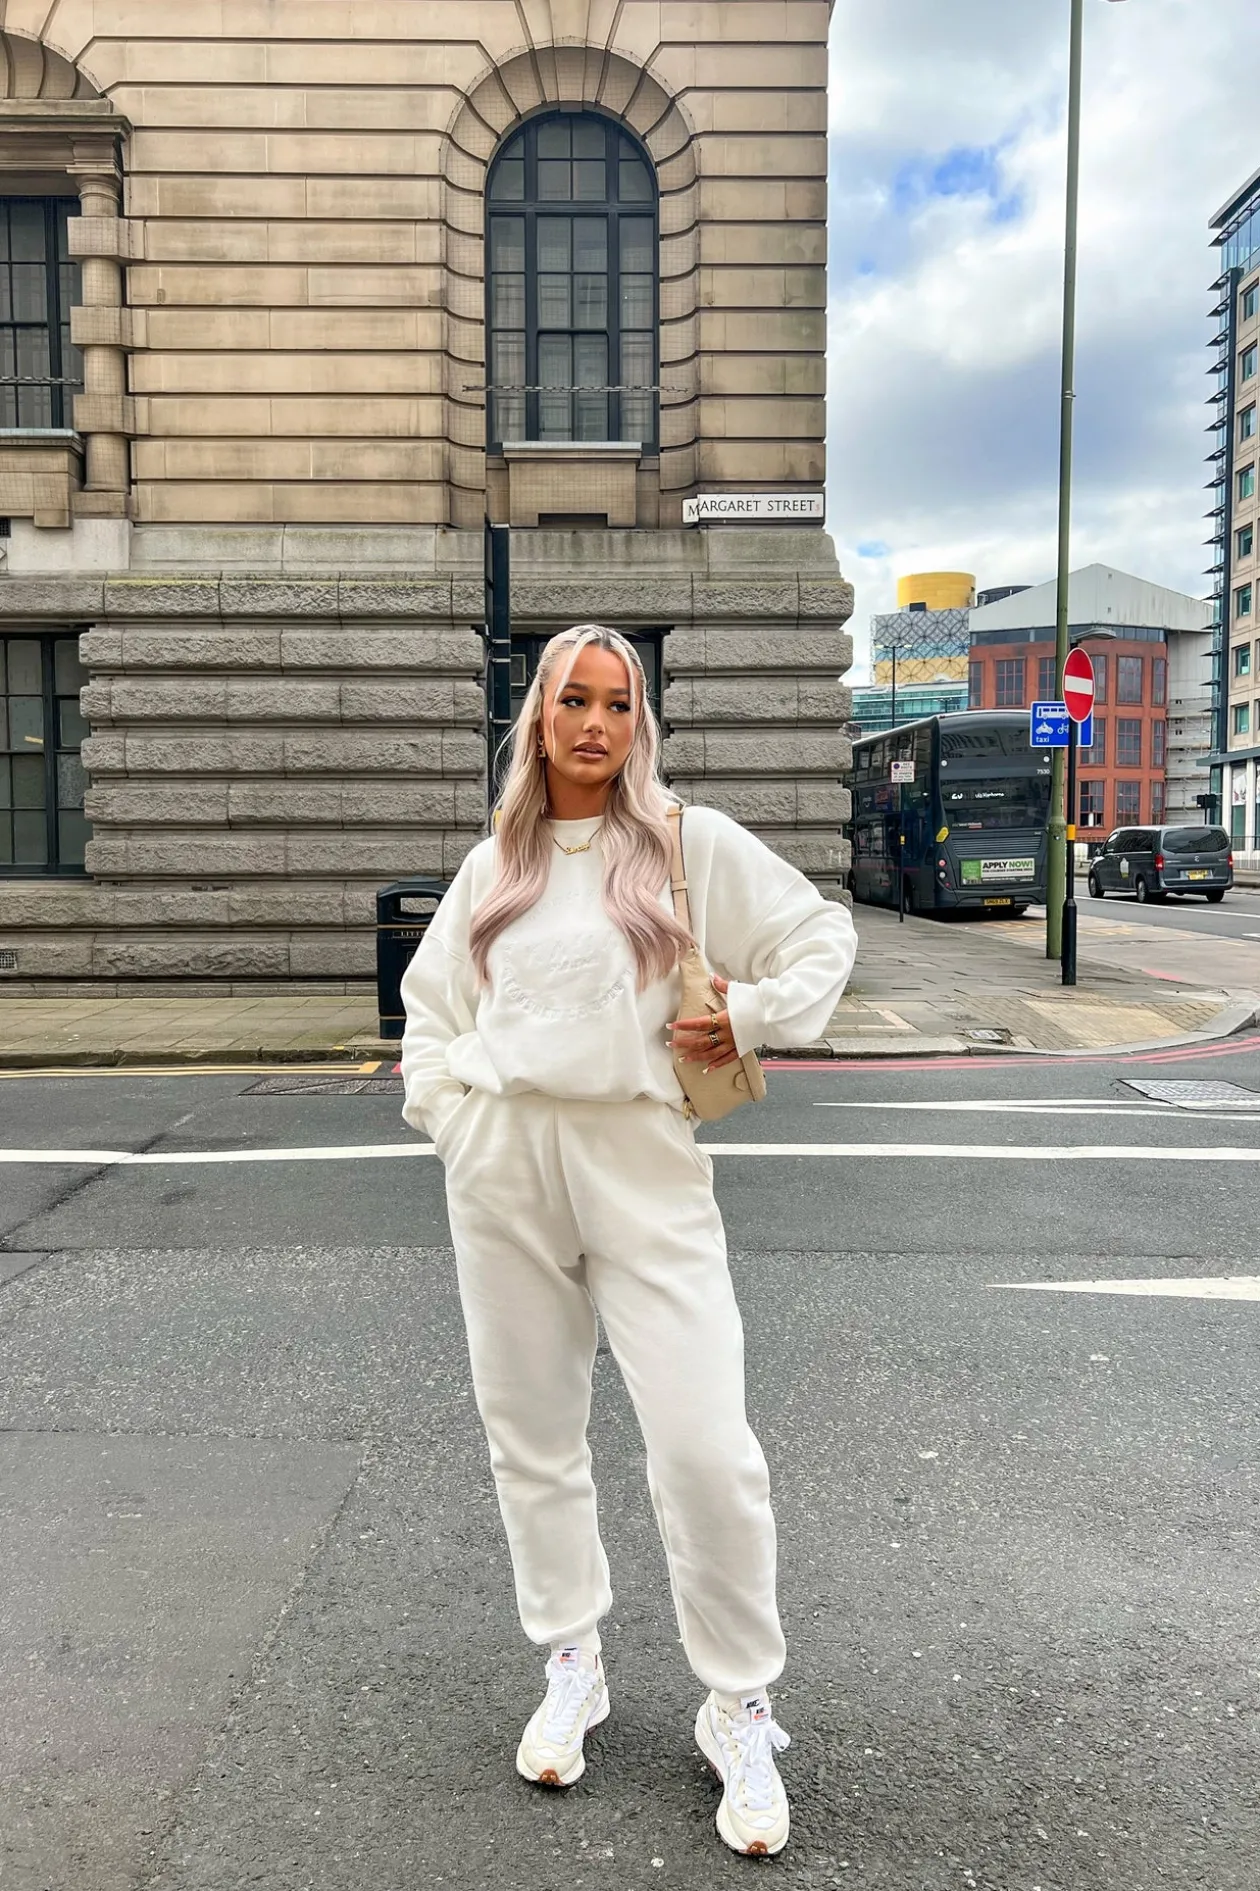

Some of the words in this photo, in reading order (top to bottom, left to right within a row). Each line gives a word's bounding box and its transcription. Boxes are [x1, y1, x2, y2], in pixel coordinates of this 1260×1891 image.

[688, 500, 761, 516] MARGARET
[768, 500, 815, 512] STREET
[983, 861, 1008, 869] APPLY
[1009, 860, 1033, 868] NOW!
